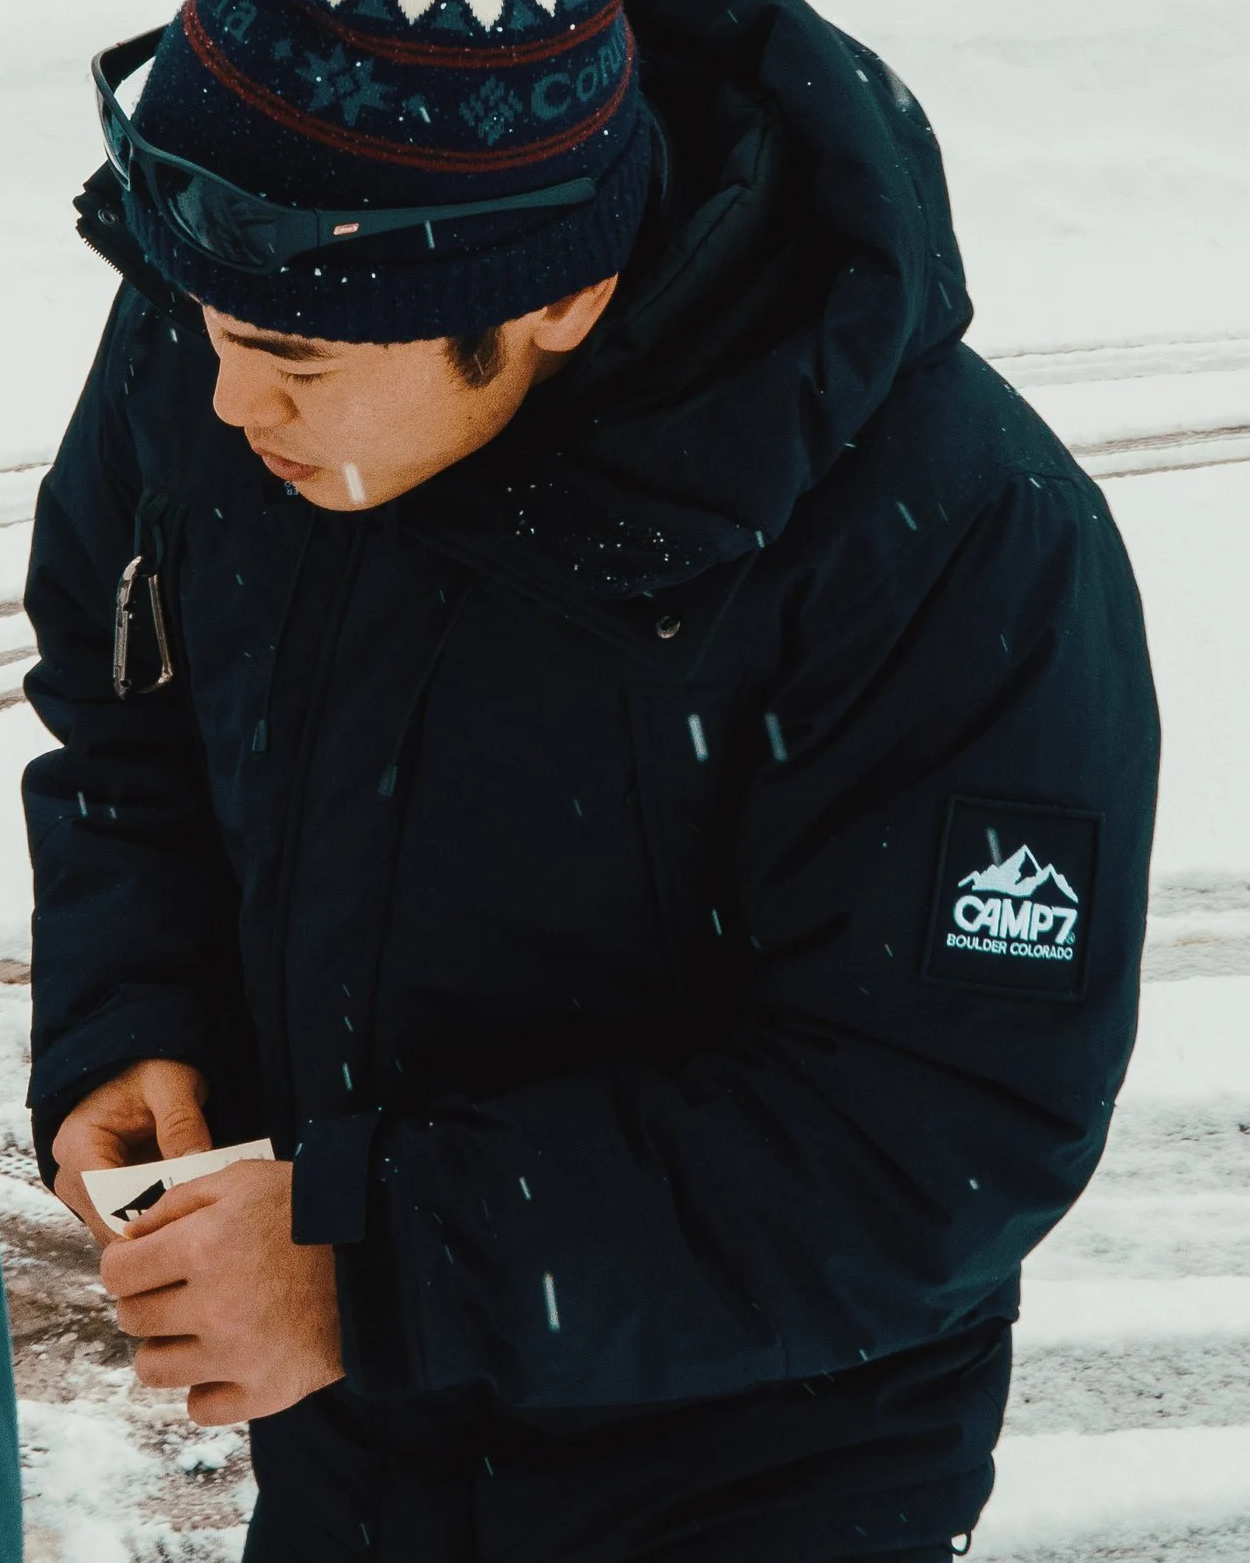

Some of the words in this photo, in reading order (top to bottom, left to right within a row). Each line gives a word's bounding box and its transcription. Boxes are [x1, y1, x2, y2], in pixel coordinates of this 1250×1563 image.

[953, 894, 1078, 946] CAMP7
[946, 932, 1008, 955] BOULDER
[1009, 942, 1074, 961] COLORADO
